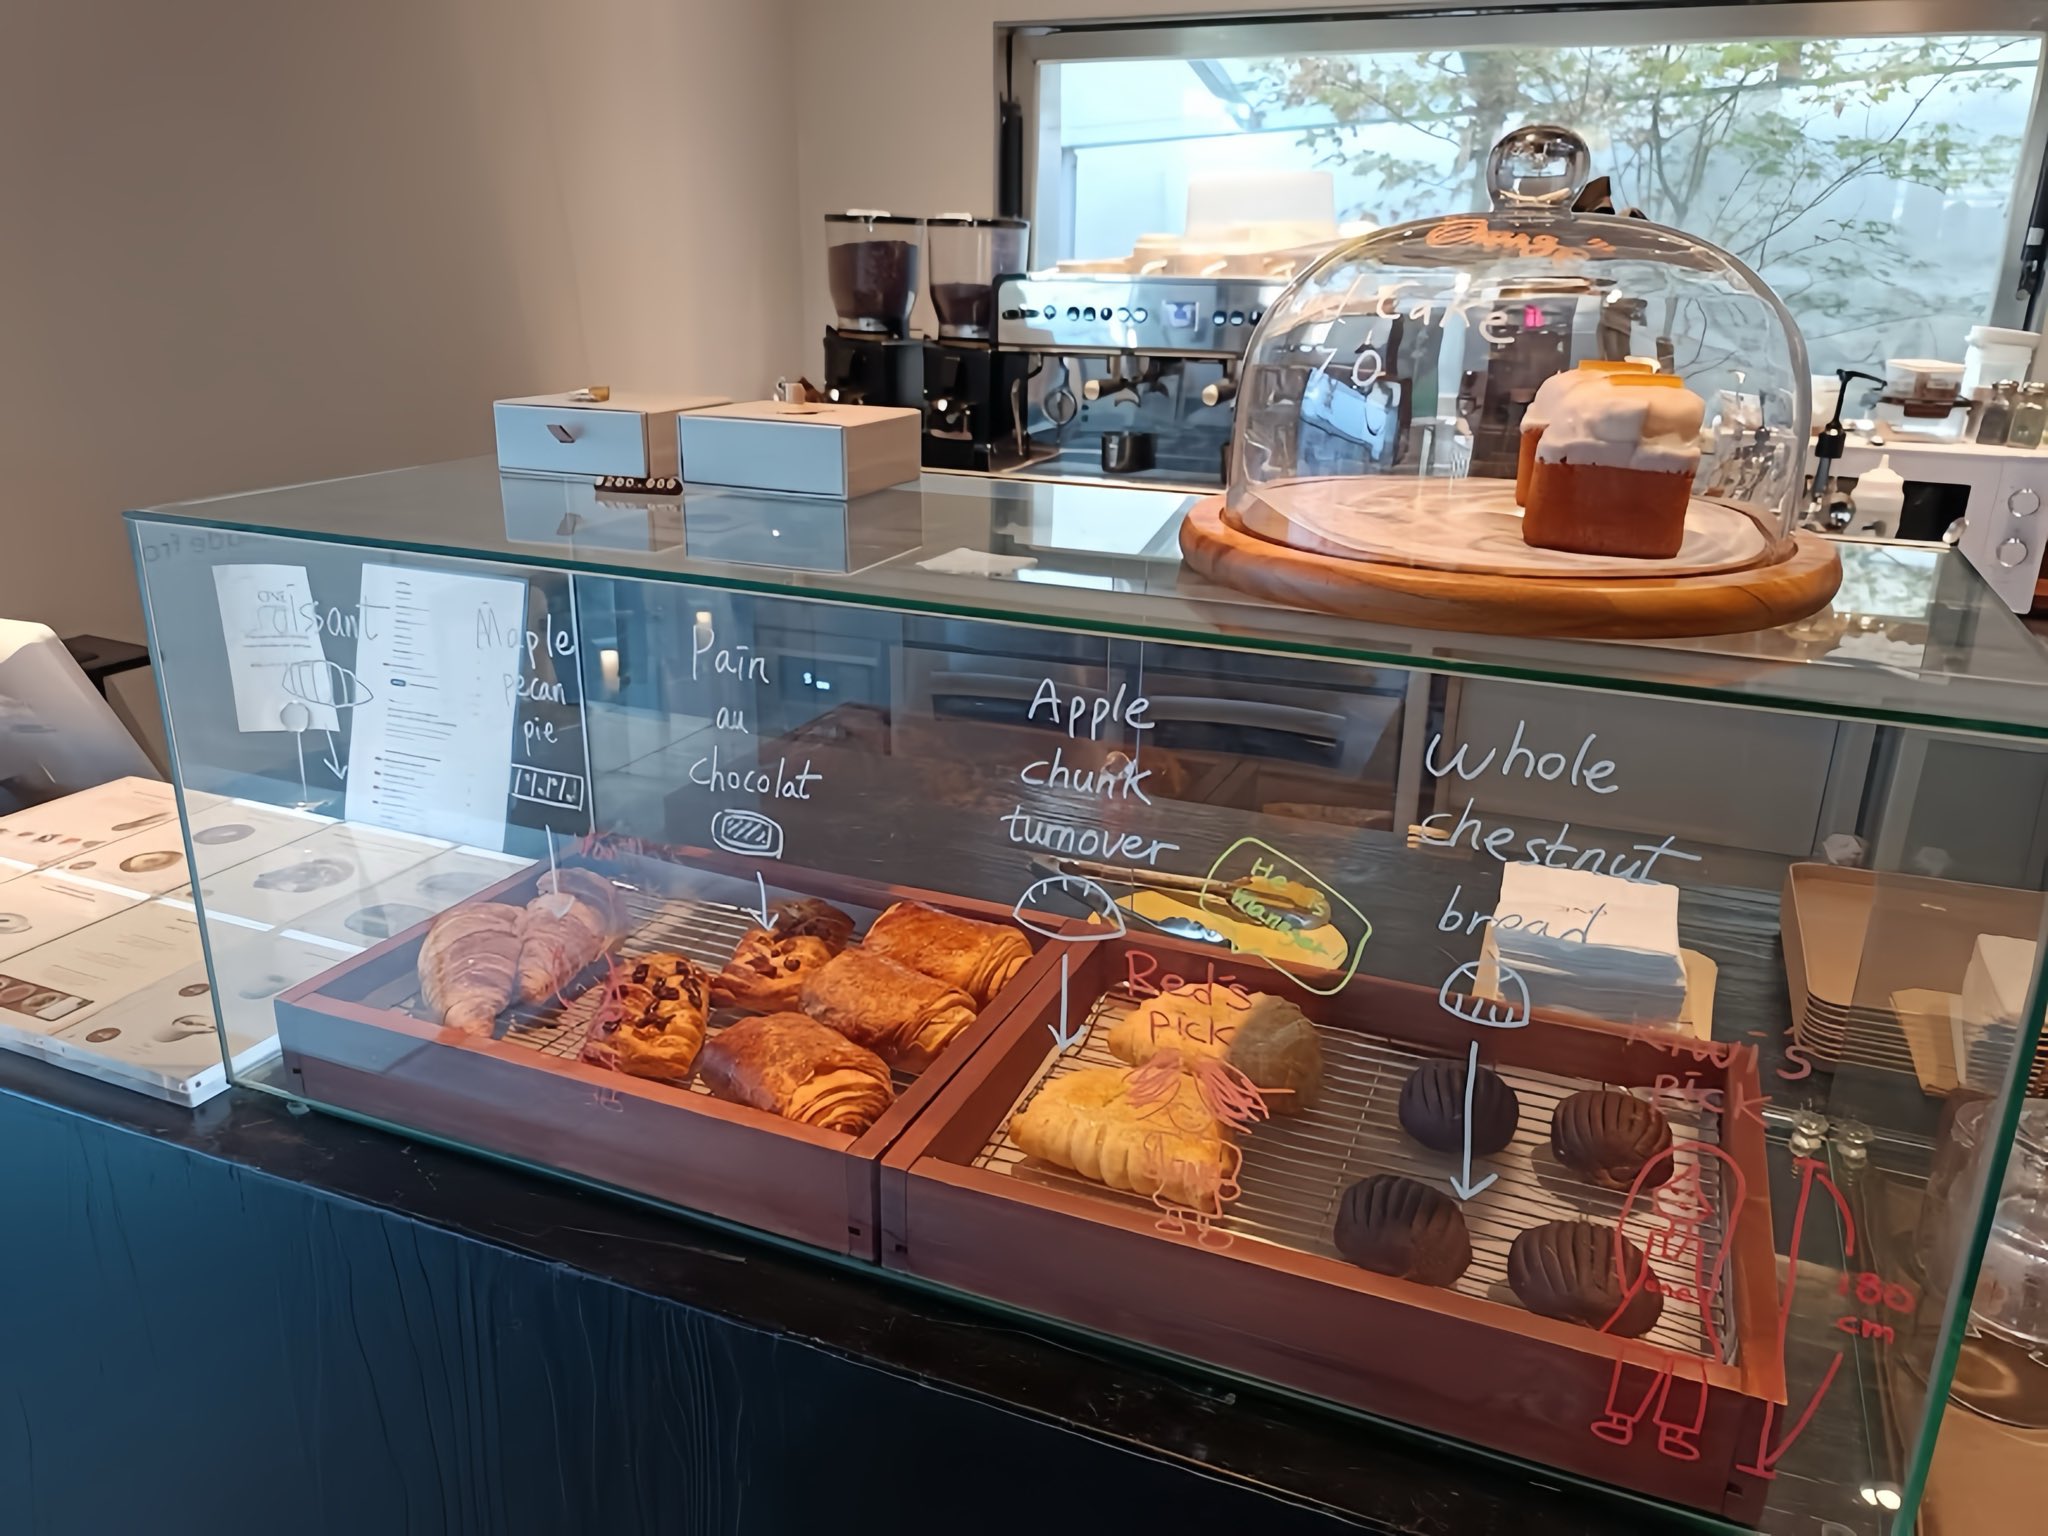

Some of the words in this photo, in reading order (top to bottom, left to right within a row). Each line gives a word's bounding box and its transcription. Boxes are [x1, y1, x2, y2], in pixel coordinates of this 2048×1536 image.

[477, 601, 575, 669] Maple
[692, 623, 770, 685] Pain
[503, 673, 567, 706] pecan
[1027, 677, 1156, 740] Apple
[523, 716, 559, 757] pie
[716, 706, 749, 735] au
[1020, 748, 1152, 806] chunk
[1001, 804, 1180, 865] turnover
[1420, 797, 1702, 885] chestnut
[1836, 1271, 1917, 1314] 180
[1835, 1316, 1896, 1345] cm
